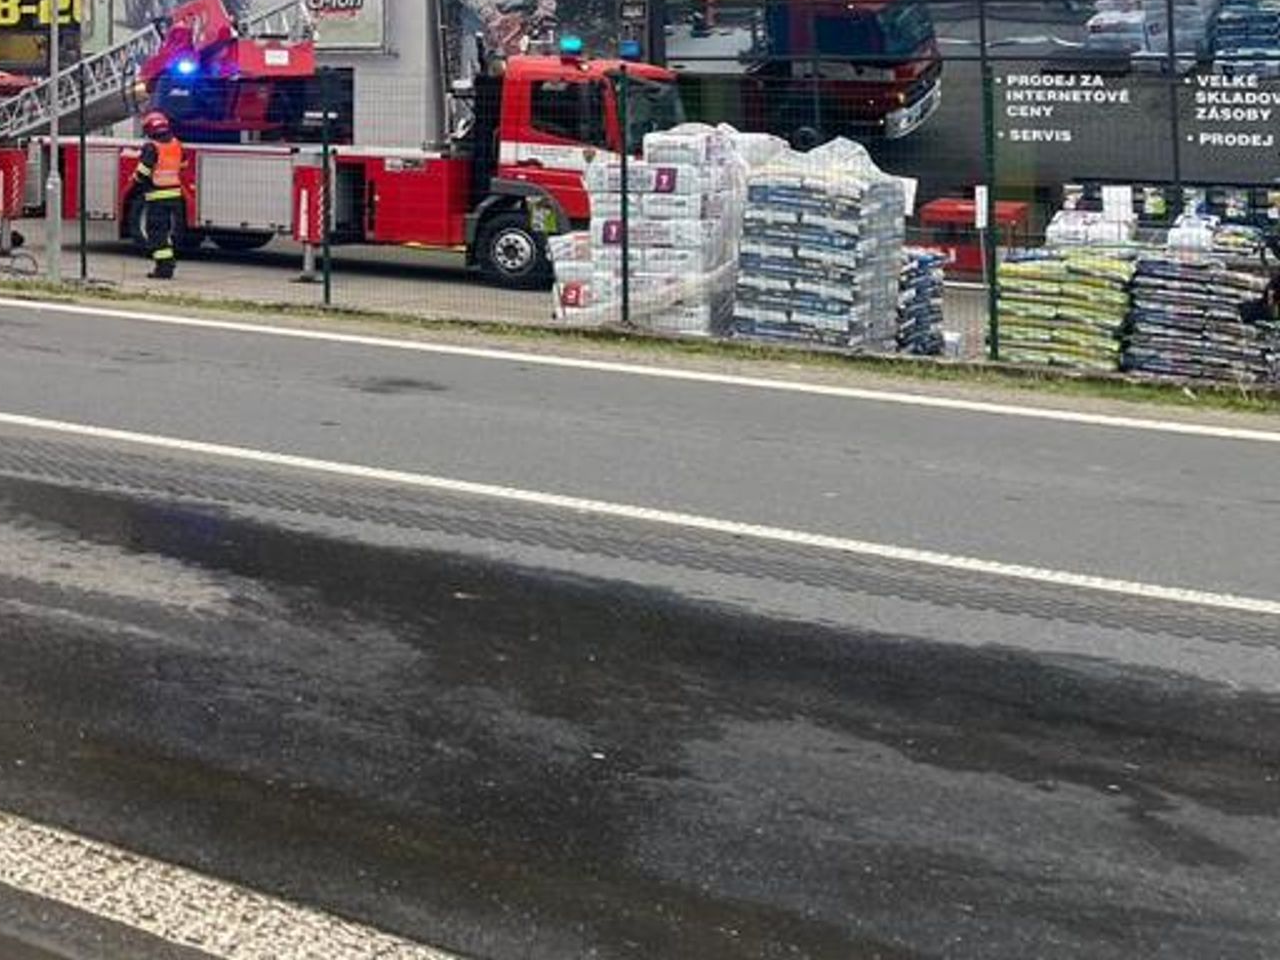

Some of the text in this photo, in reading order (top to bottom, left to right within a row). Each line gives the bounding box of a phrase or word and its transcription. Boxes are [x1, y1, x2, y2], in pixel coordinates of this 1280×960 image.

[1006, 74, 1104, 87] PRODEJ ZA
[1196, 72, 1258, 88] VELKÉ
[1006, 87, 1129, 103] INTERNETOVÉ
[1006, 104, 1054, 117] CENY
[1195, 105, 1272, 121] ZÁSOBY
[1009, 129, 1072, 142] SERVIS
[1200, 132, 1274, 147] PRODEJ
